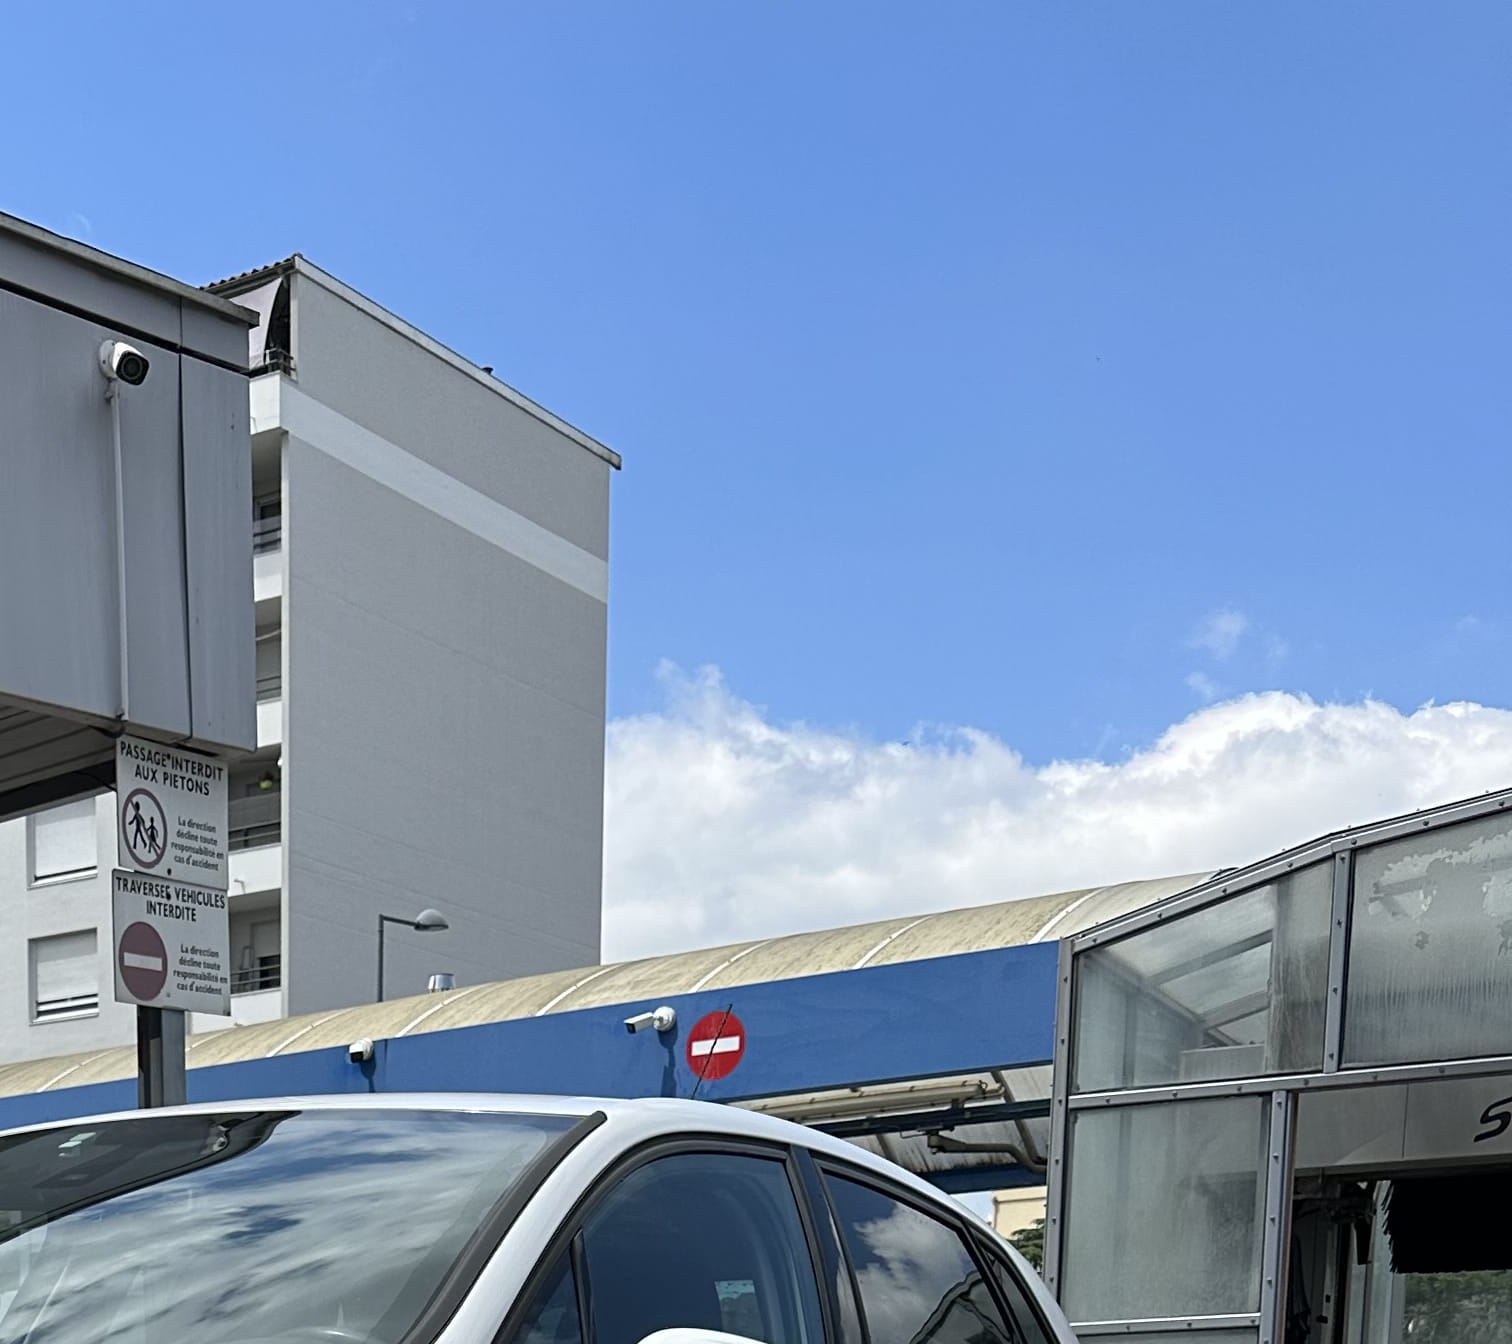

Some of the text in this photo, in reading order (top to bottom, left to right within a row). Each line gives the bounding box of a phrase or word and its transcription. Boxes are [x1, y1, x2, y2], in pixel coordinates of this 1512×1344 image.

[120, 741, 224, 781] PASSAGE INTERDIT
[135, 764, 210, 795] AUX PIETONS
[178, 816, 216, 833] La direction
[174, 887, 226, 909] VEHICULES
[146, 900, 197, 921] INTERDITE
[180, 943, 219, 958] La direction
